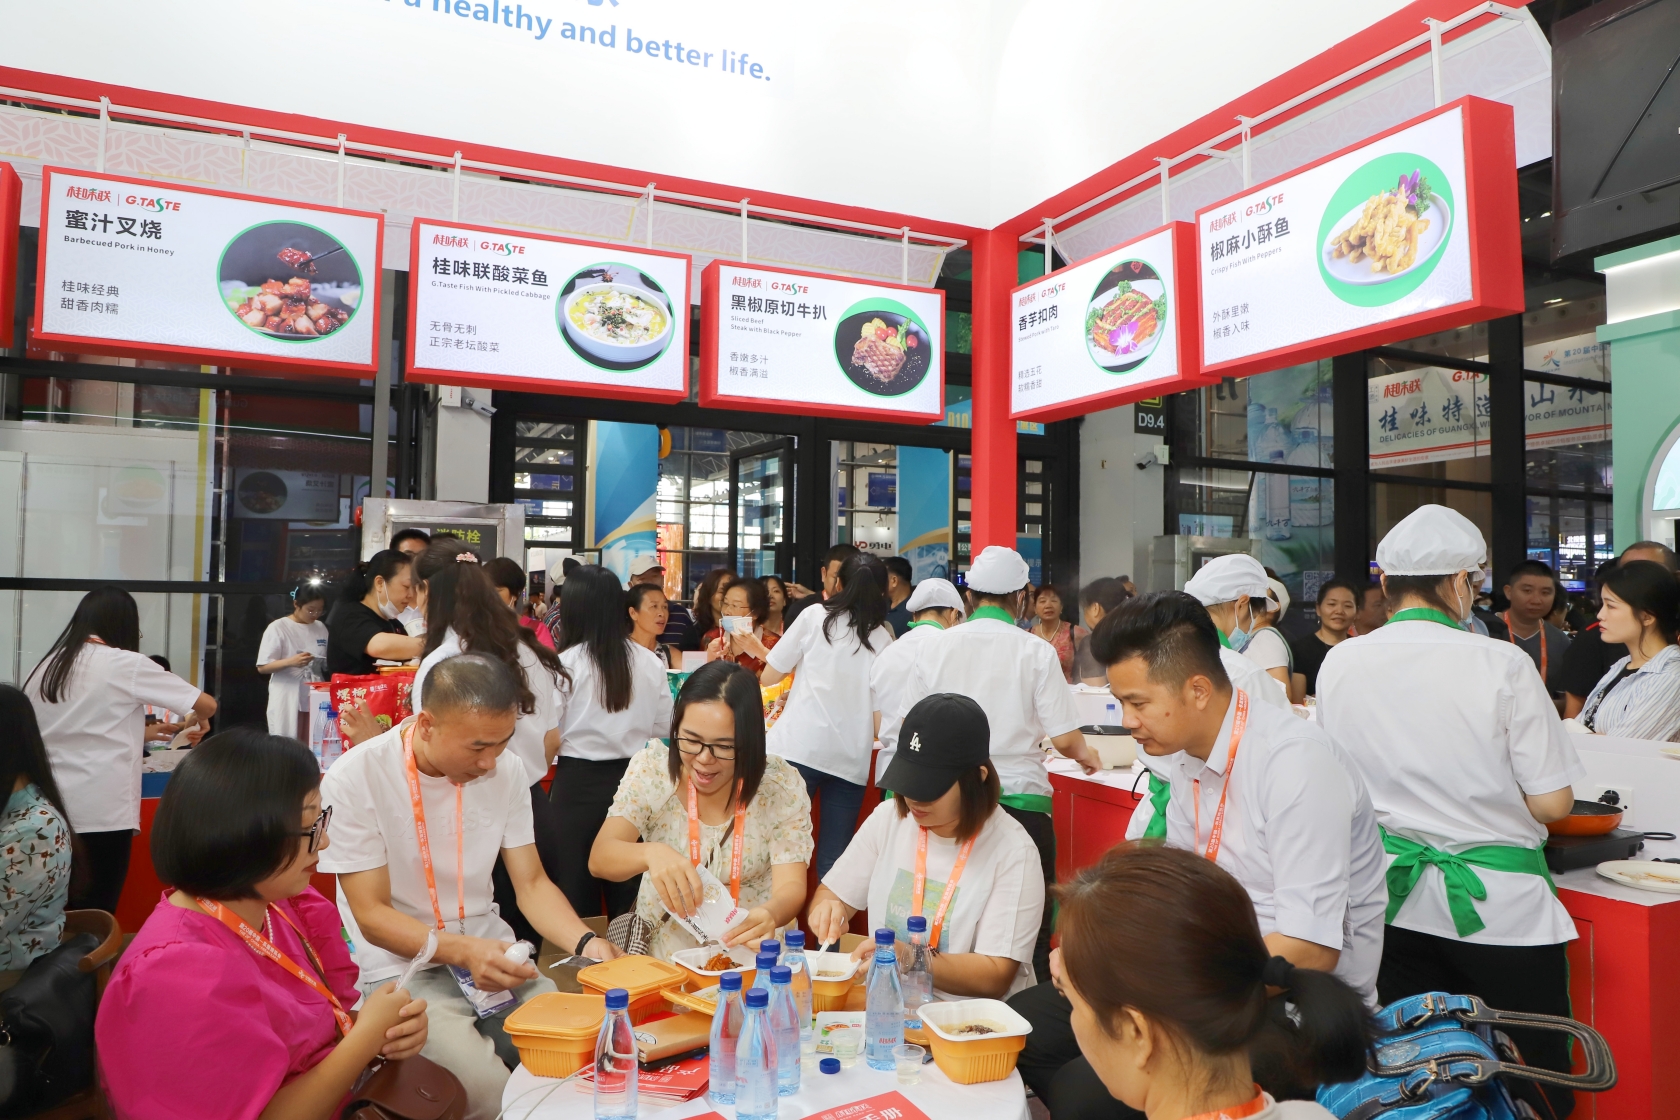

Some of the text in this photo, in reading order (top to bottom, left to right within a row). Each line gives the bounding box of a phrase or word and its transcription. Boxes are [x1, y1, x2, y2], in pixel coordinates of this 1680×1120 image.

[560, 23, 617, 49] and
[625, 28, 714, 69] better
[721, 48, 773, 82] life.
[66, 185, 181, 213] 桂味联 G.TASTE
[1209, 193, 1284, 233] 桂味联 G.TASTE
[65, 209, 162, 240] 蜜汁叉烧
[64, 235, 175, 256] Barbecued Pork in Honey
[432, 234, 525, 256] 桂味联 G.TASTE
[1210, 216, 1291, 262] 椒麻小酥鱼
[1210, 246, 1283, 276] Crispy Fish With Peppers
[432, 257, 549, 287] 桂味联酸菜鱼
[61, 279, 120, 298] 桂味经典
[431, 281, 551, 300] G.Taste Fish With Pickled Cabbage
[731, 276, 809, 296] 桂味联 G.TASTE
[1041, 282, 1066, 299] G.TASTE
[60, 297, 119, 315] 甜香肉糯
[731, 293, 828, 321] 黑椒原切牛扒
[1212, 302, 1250, 324] 外酥里嫩
[430, 320, 477, 336] 无骨无刺
[730, 315, 764, 325] Sliced Beef
[1018, 304, 1058, 332] 香芋扣肉
[780, 330, 802, 338] Pepper
[1213, 320, 1250, 340] 椒香入味
[429, 336, 500, 353] 正宗老坛酸菜
[730, 351, 769, 365] 香嫩多汁
[729, 366, 769, 379] 椒香满溢
[1138, 412, 1165, 429] D9.4
[1543, 411, 1556, 419] OF
[1380, 430, 1425, 443] DELICACIES
[1426, 427, 1437, 436] OF
[1438, 421, 1480, 435] GUANGX,
[909, 732, 922, 752] LA
